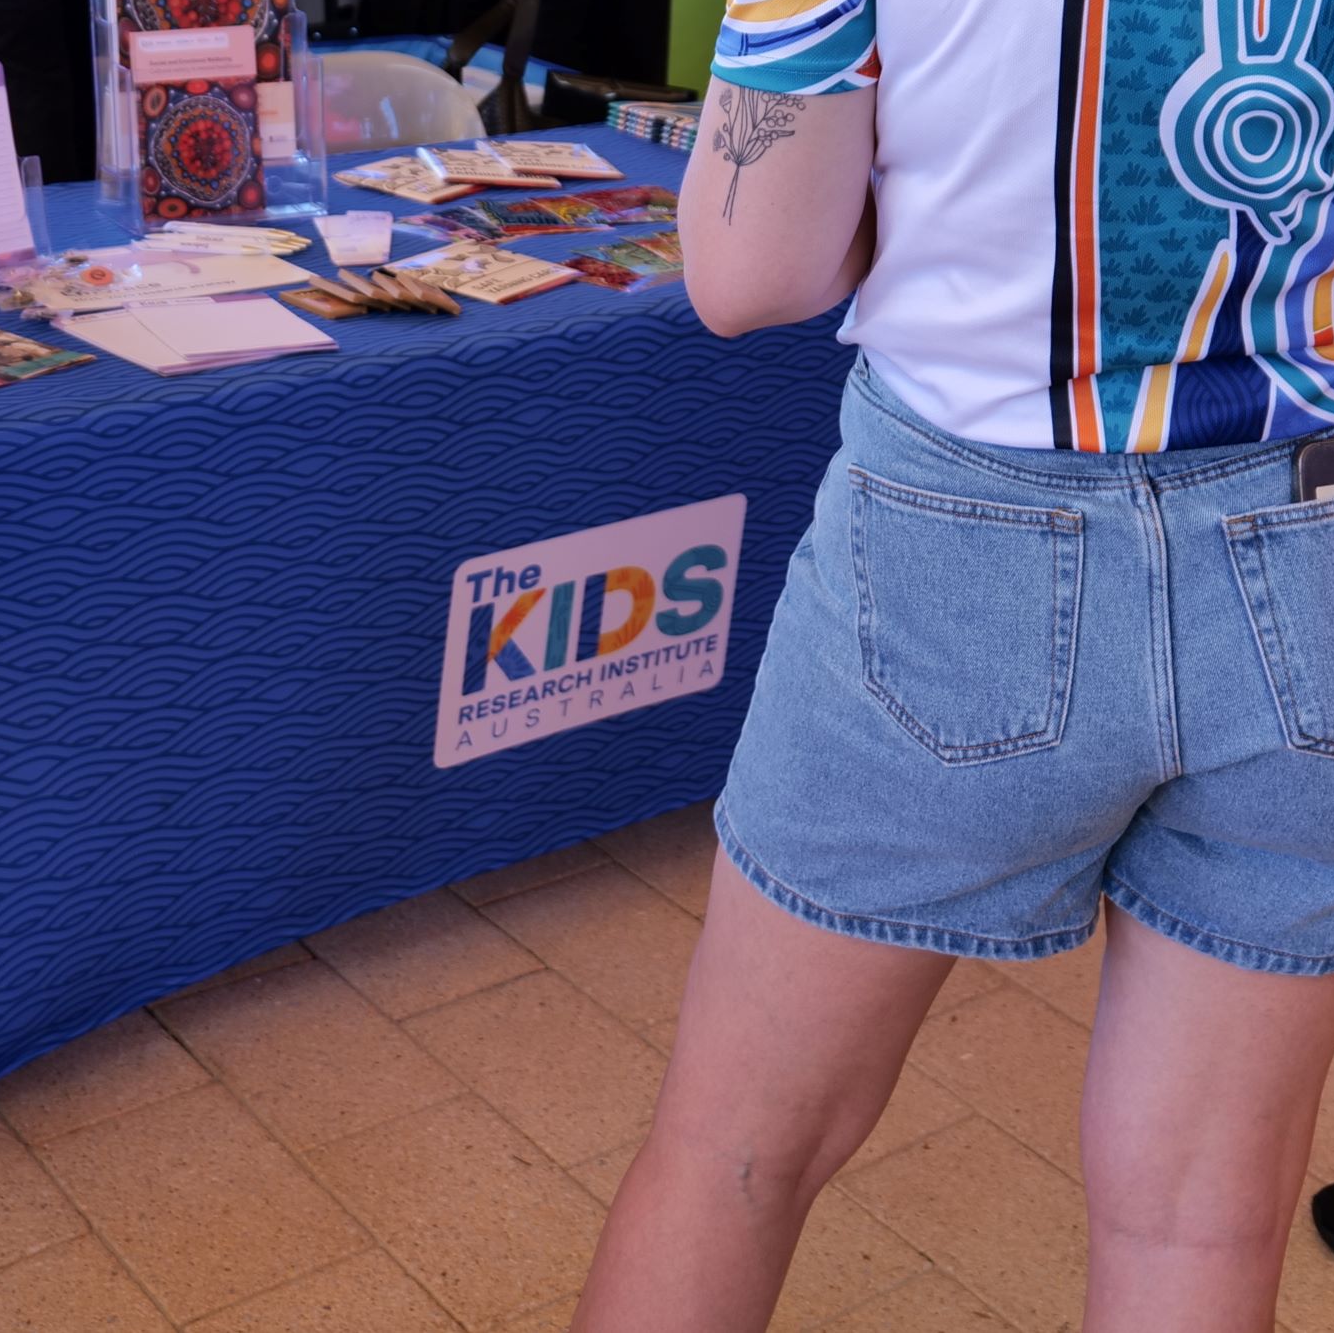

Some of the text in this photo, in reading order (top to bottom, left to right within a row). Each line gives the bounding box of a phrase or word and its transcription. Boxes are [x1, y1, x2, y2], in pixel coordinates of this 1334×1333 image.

[462, 544, 728, 697] KIDS
[467, 563, 542, 603] The
[455, 659, 715, 751] AUSTRALIA
[457, 634, 718, 725] RESEARCH INSTITUTE
